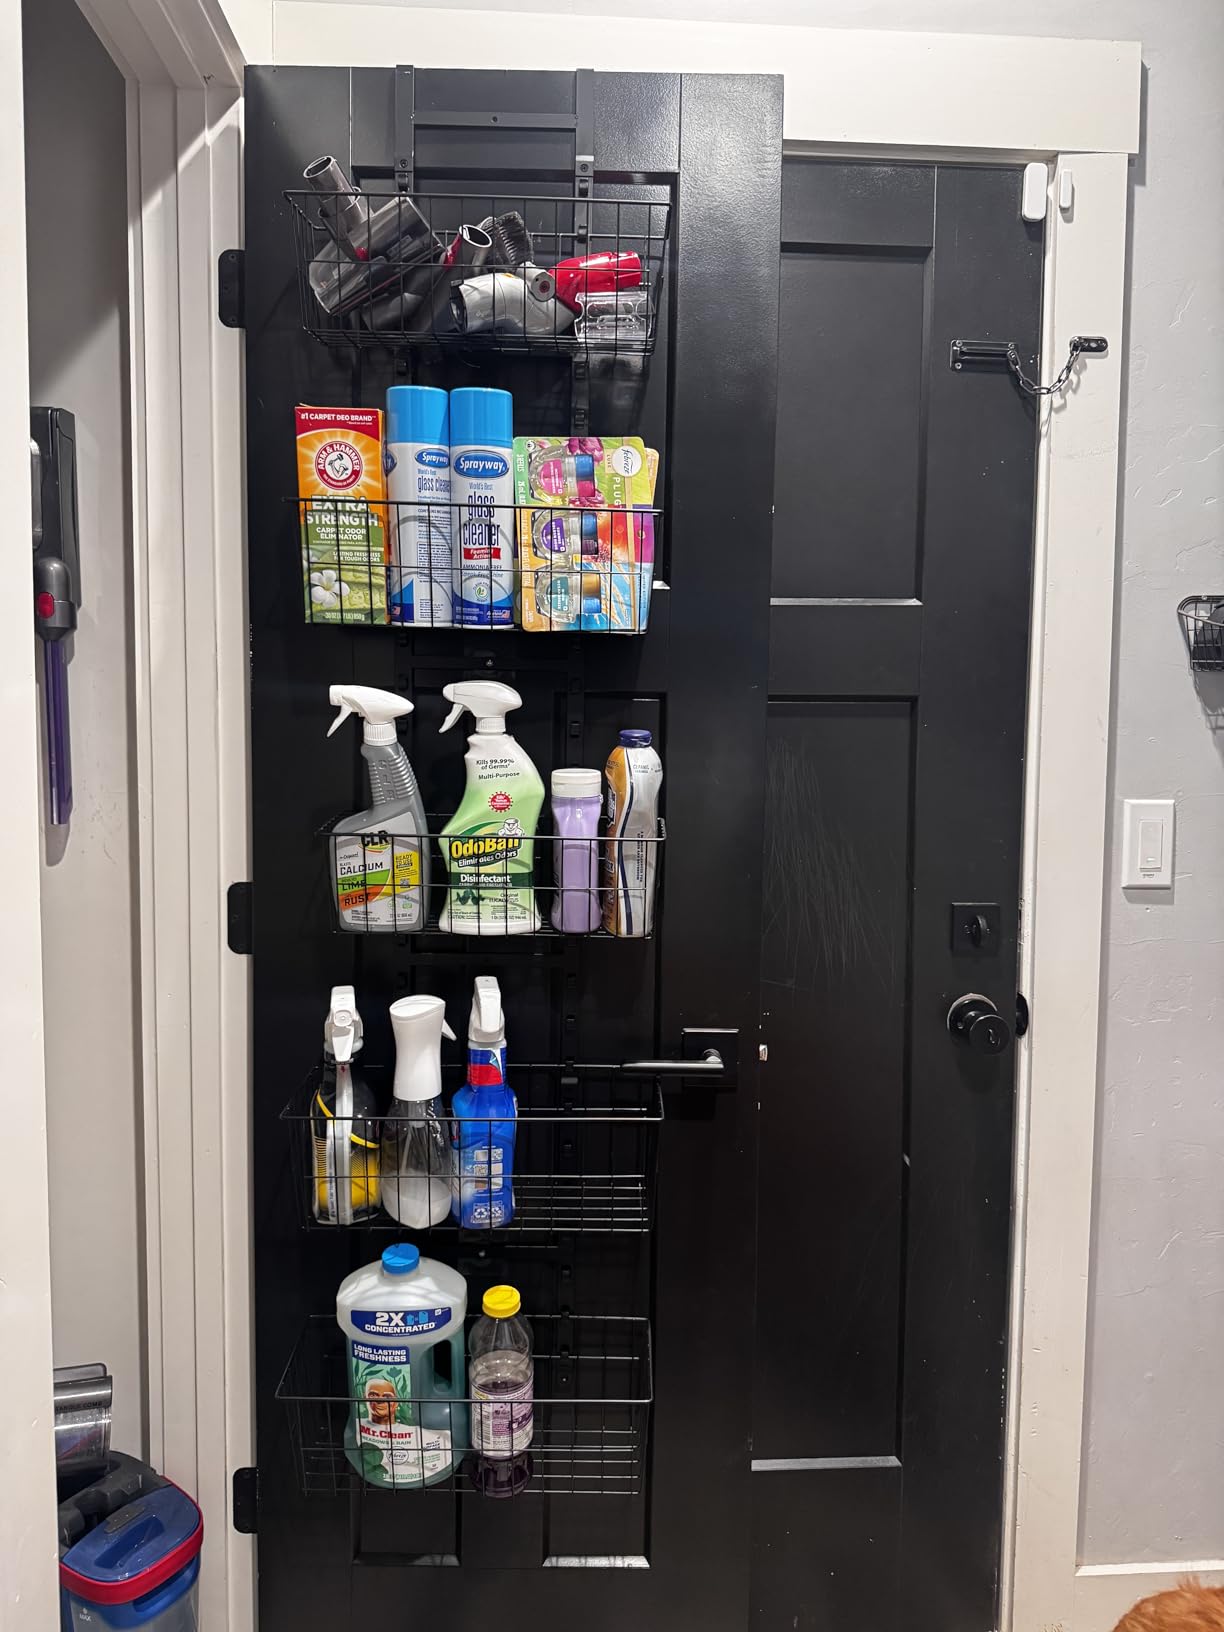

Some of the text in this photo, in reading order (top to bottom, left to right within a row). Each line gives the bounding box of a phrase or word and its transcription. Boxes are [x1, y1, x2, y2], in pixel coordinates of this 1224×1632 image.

[309, 413, 336, 421] CARPET
[317, 451, 328, 471] ARM
[333, 443, 360, 471] HAMMER
[460, 457, 505, 473] Sprayway
[621, 448, 634, 475] febreze
[417, 476, 434, 493] glass
[612, 477, 622, 506] PLUG
[311, 496, 369, 511] EXTRA
[468, 491, 495, 521] glass
[306, 511, 379, 527] STRENGTH
[478, 772, 520, 780] Multi-Purpose
[451, 837, 519, 859] OdoBan
[364, 1321, 436, 1333] CONCENTRATED
[375, 1312, 405, 1327] 2X
[354, 1343, 407, 1356] LONG LASTING
[354, 1349, 407, 1363] FRESHNESS
